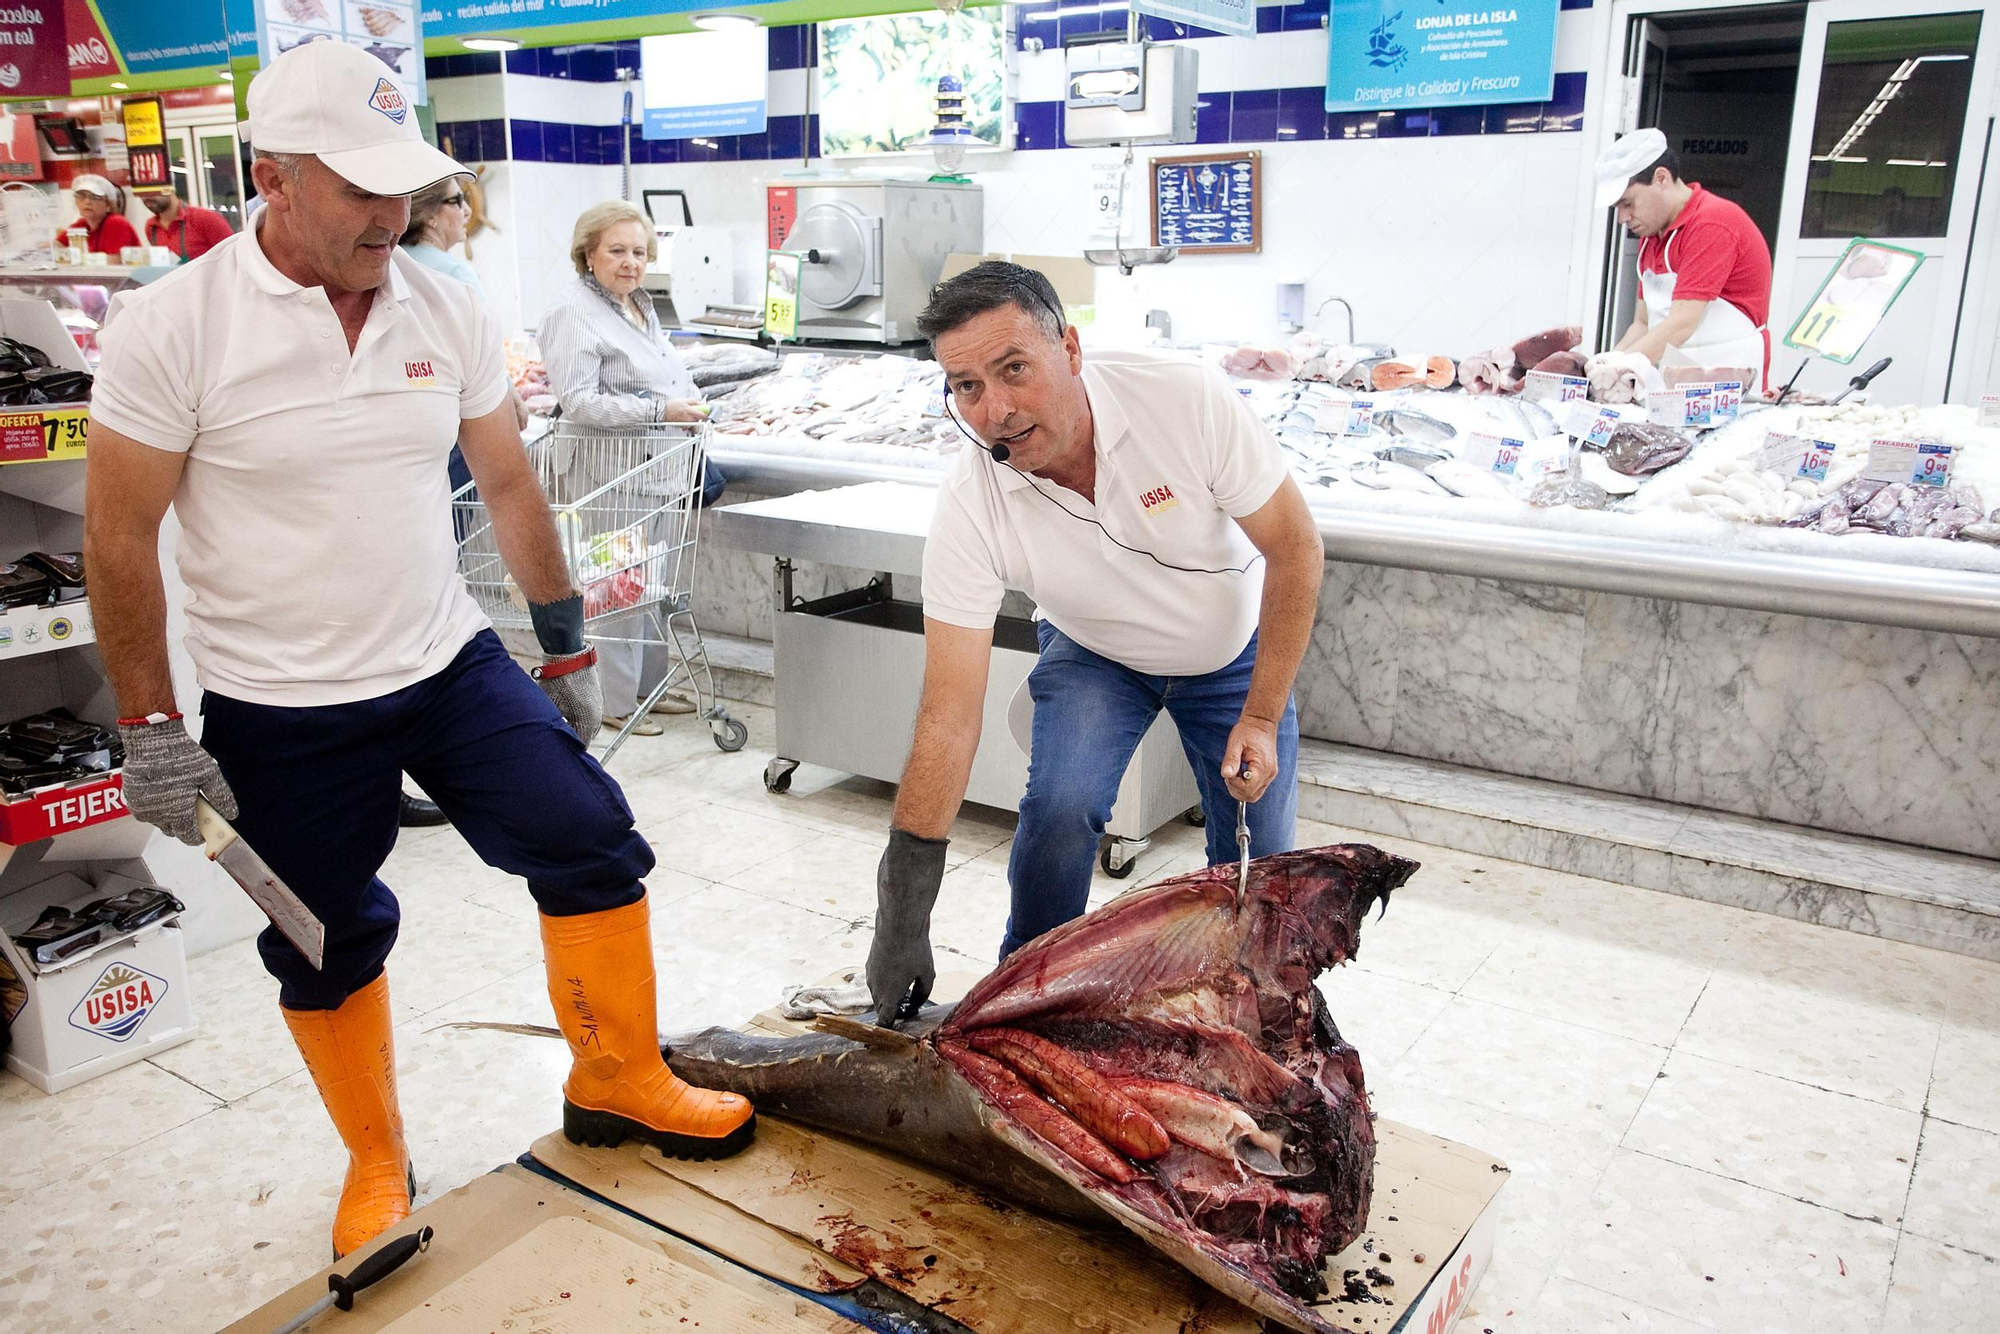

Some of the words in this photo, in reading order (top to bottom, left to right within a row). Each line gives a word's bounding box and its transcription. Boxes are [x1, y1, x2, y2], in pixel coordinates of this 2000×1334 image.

[1416, 15, 1453, 29] LONJA
[1455, 14, 1472, 26] DE
[1473, 12, 1489, 25] LA
[1491, 9, 1518, 23] ISLA
[1354, 86, 1403, 102] Distingue
[1405, 83, 1415, 97] la
[1417, 78, 1461, 96] Calidad
[1461, 79, 1470, 96] y
[1471, 76, 1520, 91] Frescura
[376, 93, 405, 110] USISA
[1682, 139, 1748, 154] PESCADOS
[405, 361, 434, 378] USISA
[0, 415, 41, 428] OFERTA
[66, 440, 86, 448] EUROS
[1140, 485, 1174, 508] USISA
[86, 980, 154, 1026] USISA
